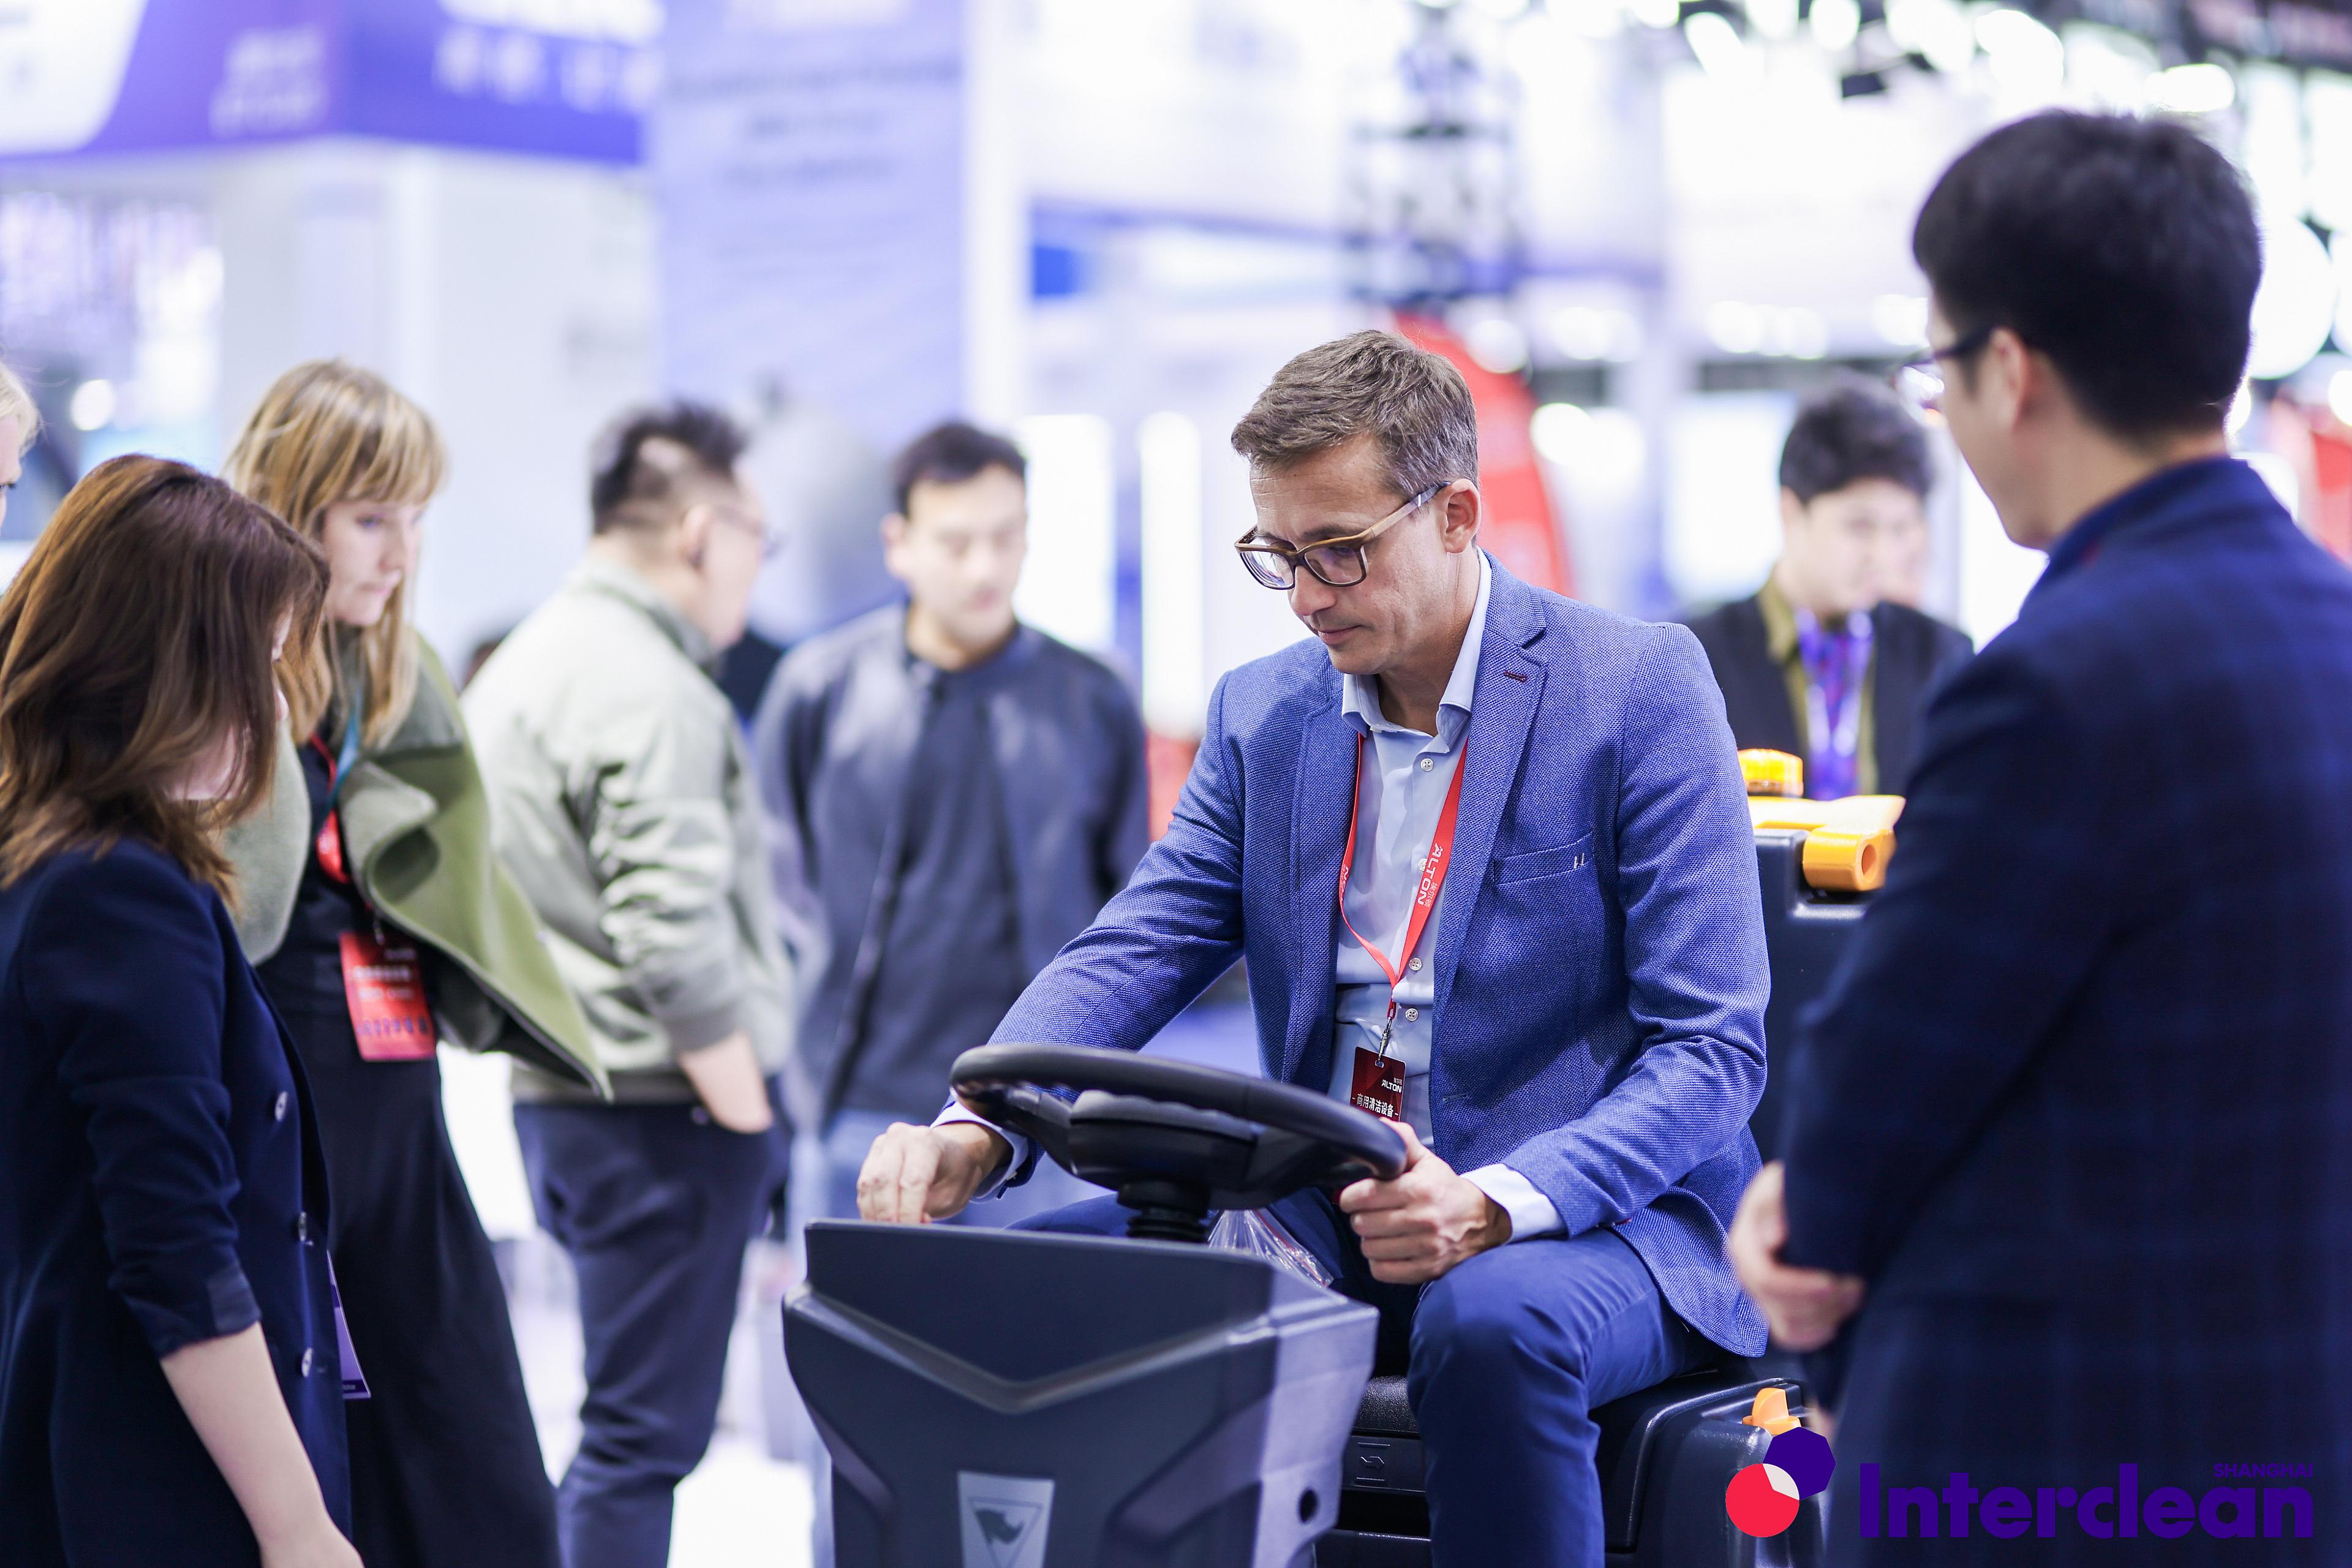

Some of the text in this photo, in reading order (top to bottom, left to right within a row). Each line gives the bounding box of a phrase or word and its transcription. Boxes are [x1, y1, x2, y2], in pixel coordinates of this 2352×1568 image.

[1417, 843, 1444, 905] ALTON
[1381, 1079, 1402, 1093] ALTON
[1357, 1093, 1394, 1118] 商用清洁设备
